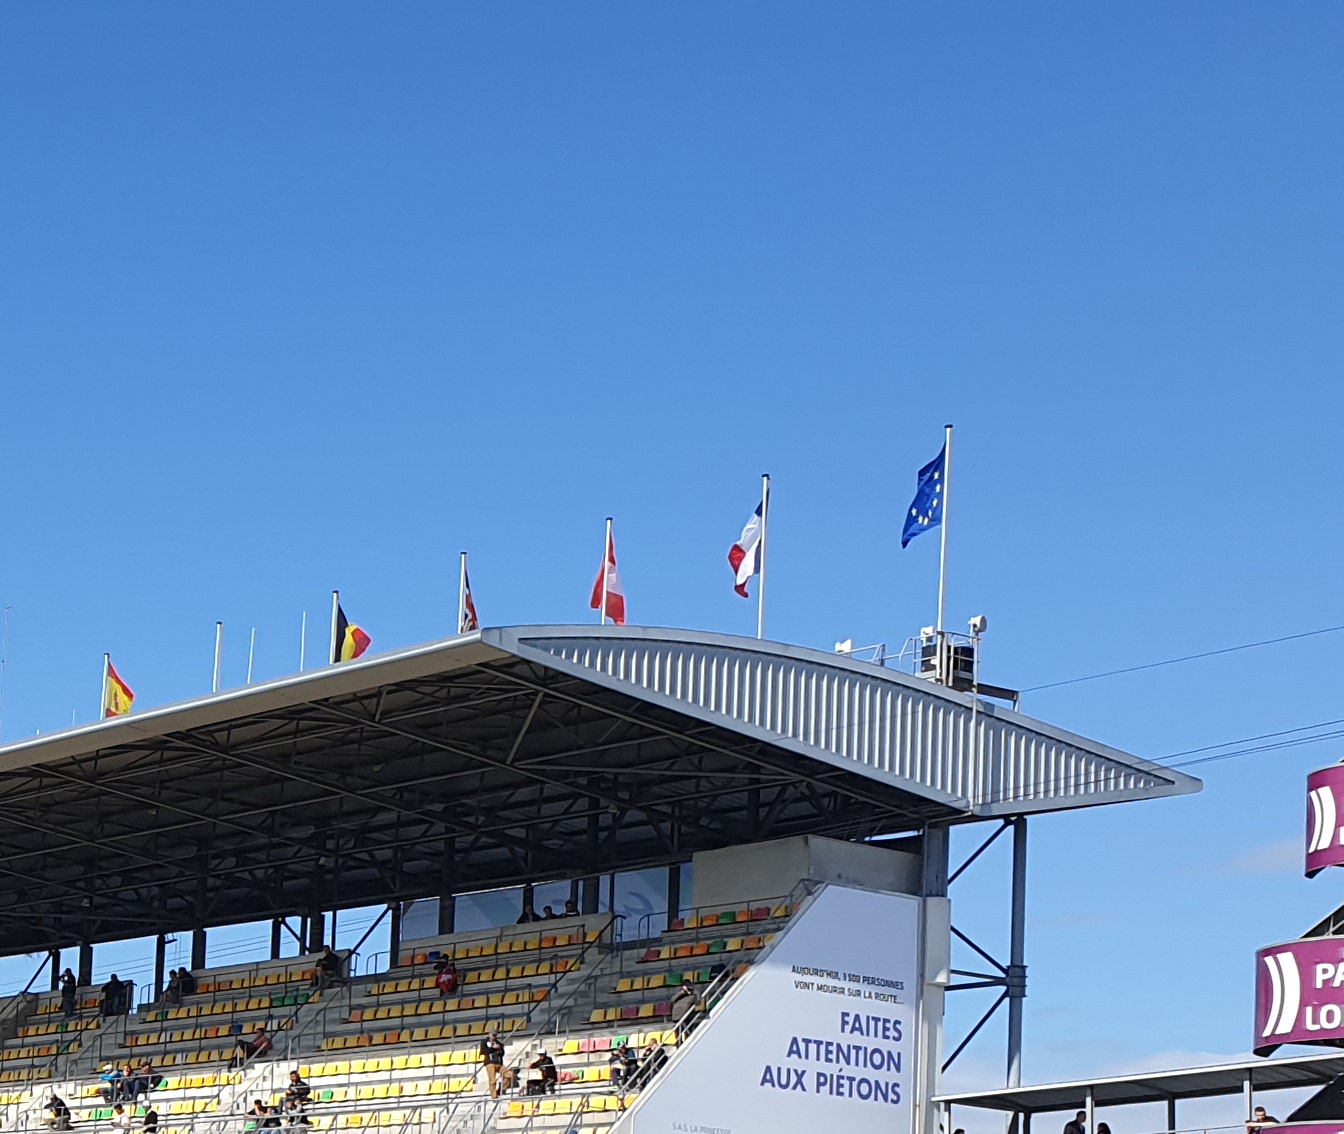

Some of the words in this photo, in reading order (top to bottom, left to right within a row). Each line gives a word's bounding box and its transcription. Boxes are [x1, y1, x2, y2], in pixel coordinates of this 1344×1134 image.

[794, 980, 815, 991] VONT
[816, 984, 845, 995] MOURIR
[847, 987, 861, 998] SUR
[863, 990, 873, 1000] LA
[1315, 963, 1344, 989] PA
[840, 1011, 903, 1042] FAITES
[786, 1036, 902, 1073] ATTENTION
[760, 1065, 807, 1092] AUX
[815, 1068, 901, 1105] PIÉTONS
